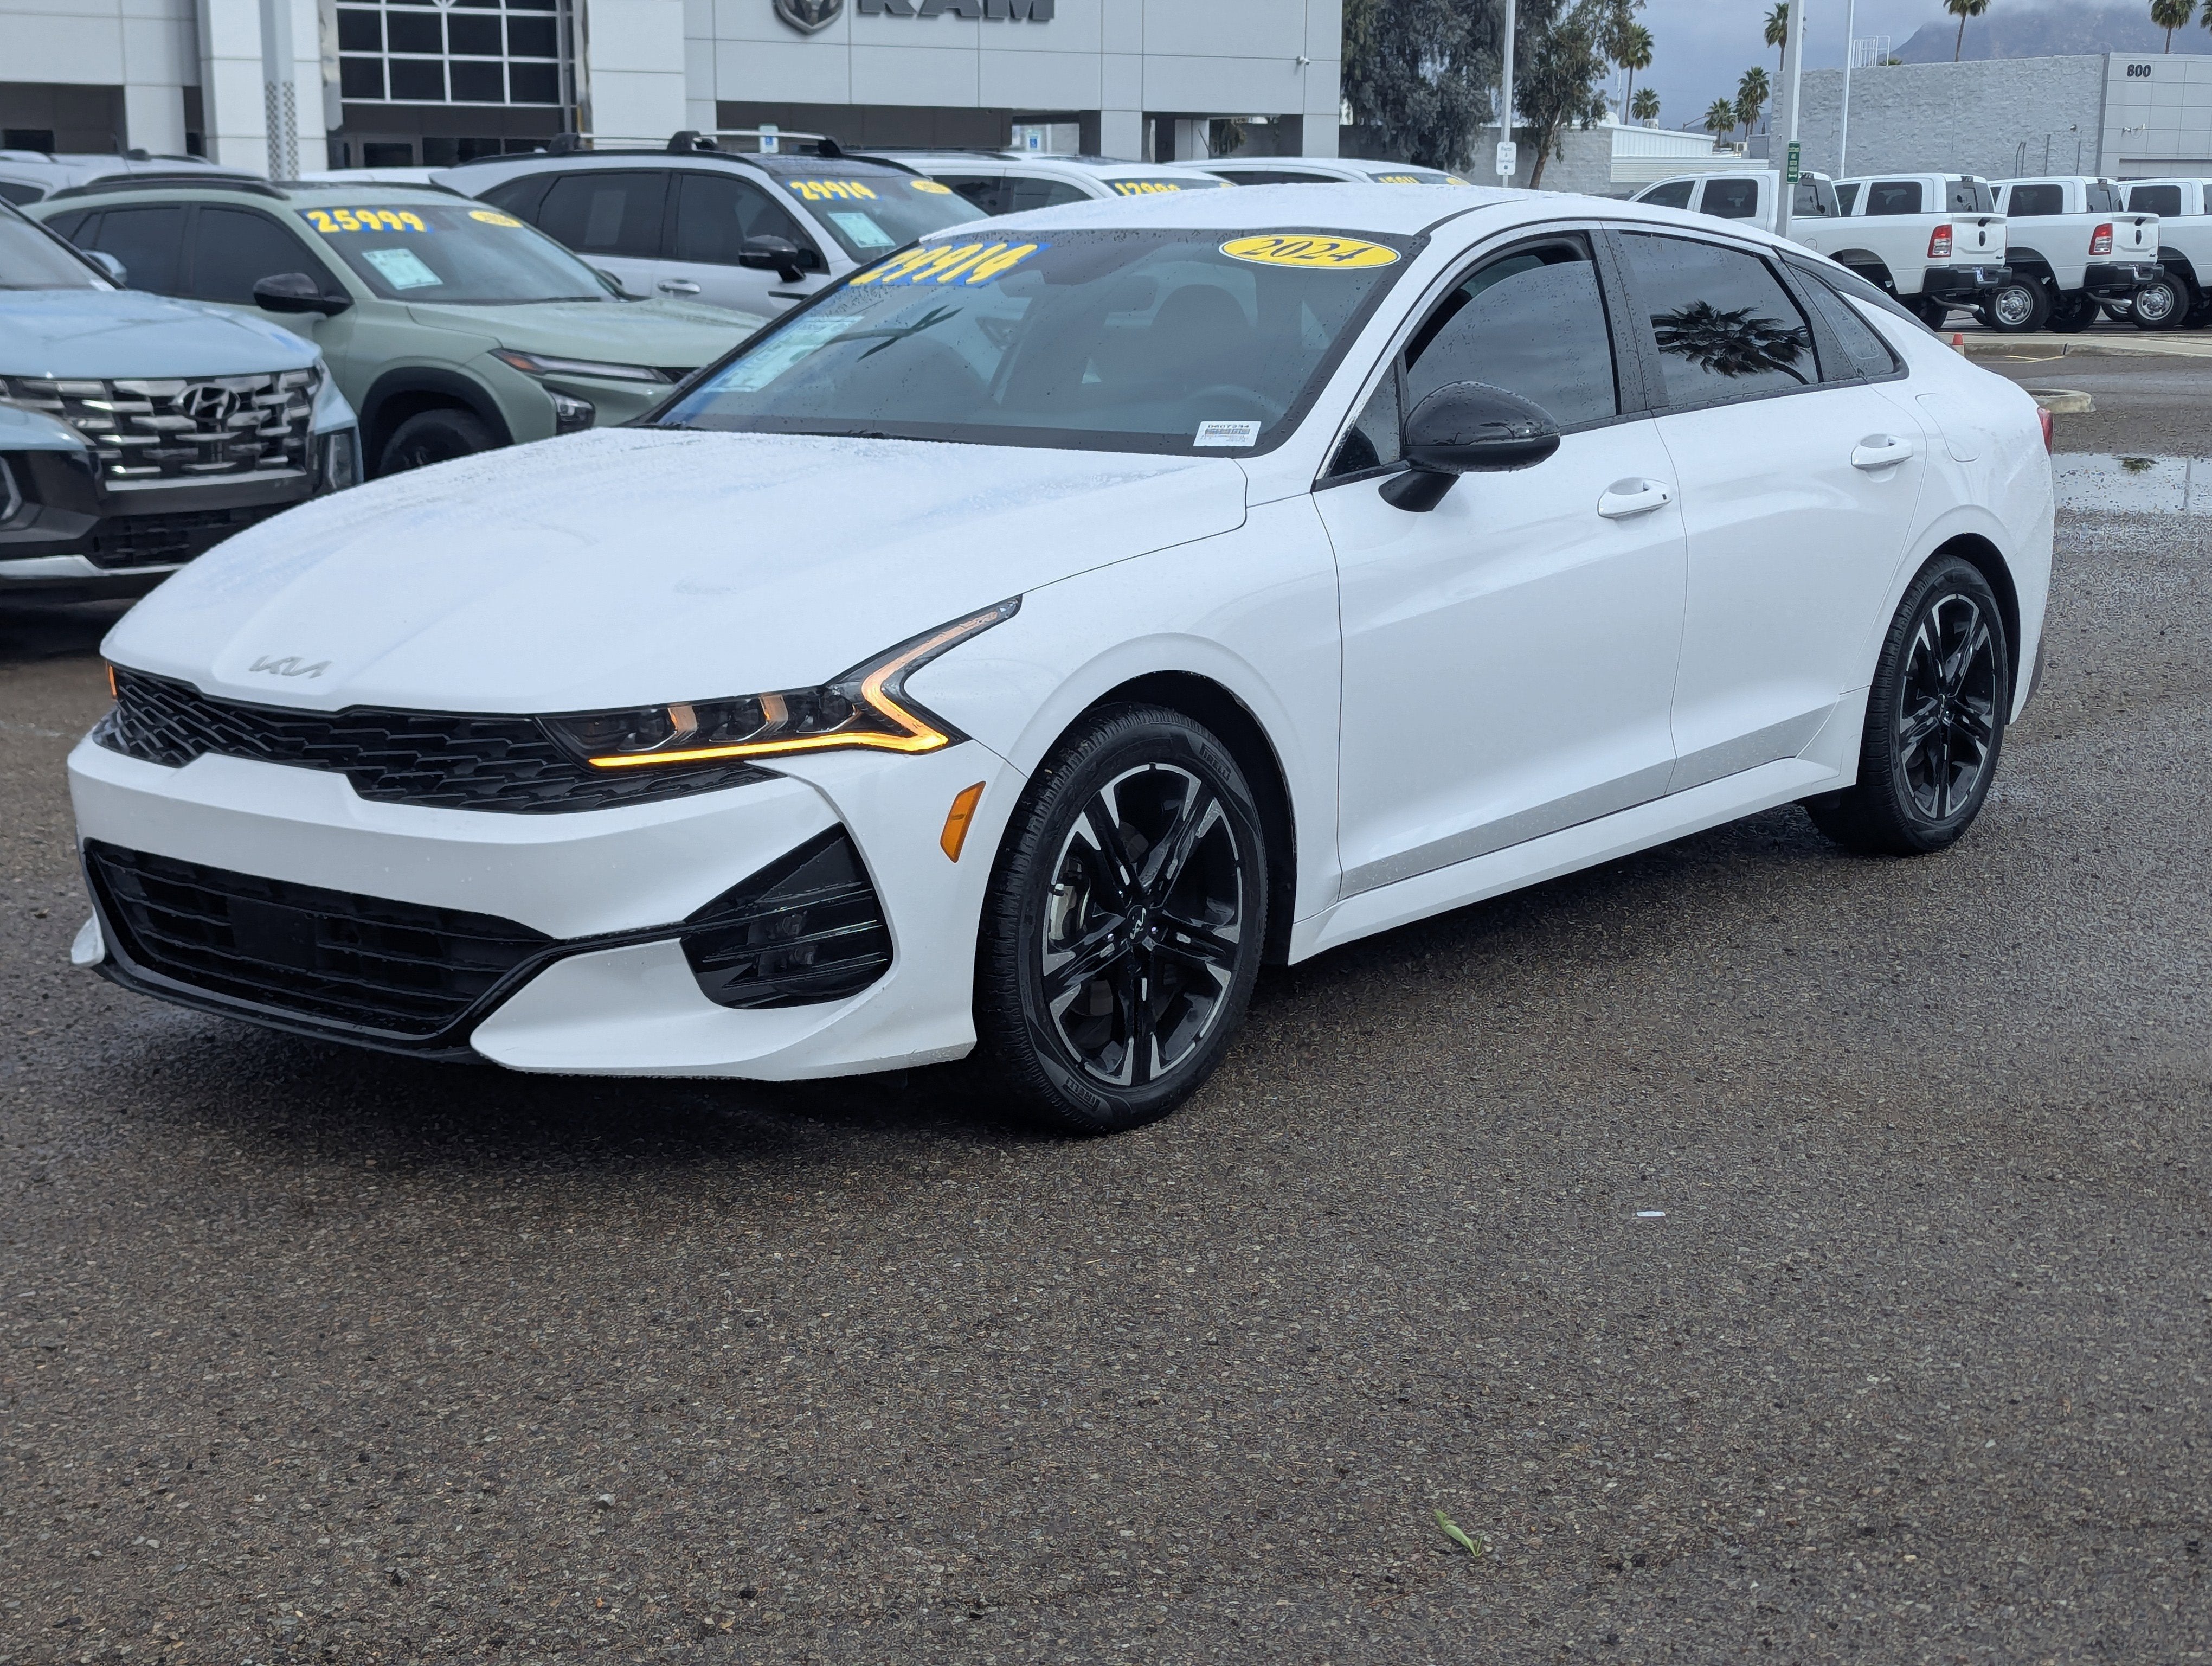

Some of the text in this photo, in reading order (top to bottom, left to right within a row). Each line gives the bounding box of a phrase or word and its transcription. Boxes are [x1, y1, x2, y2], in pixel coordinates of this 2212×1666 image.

[2127, 64, 2151, 77] 800
[307, 210, 427, 232] 25999
[1237, 239, 1374, 261] 2024
